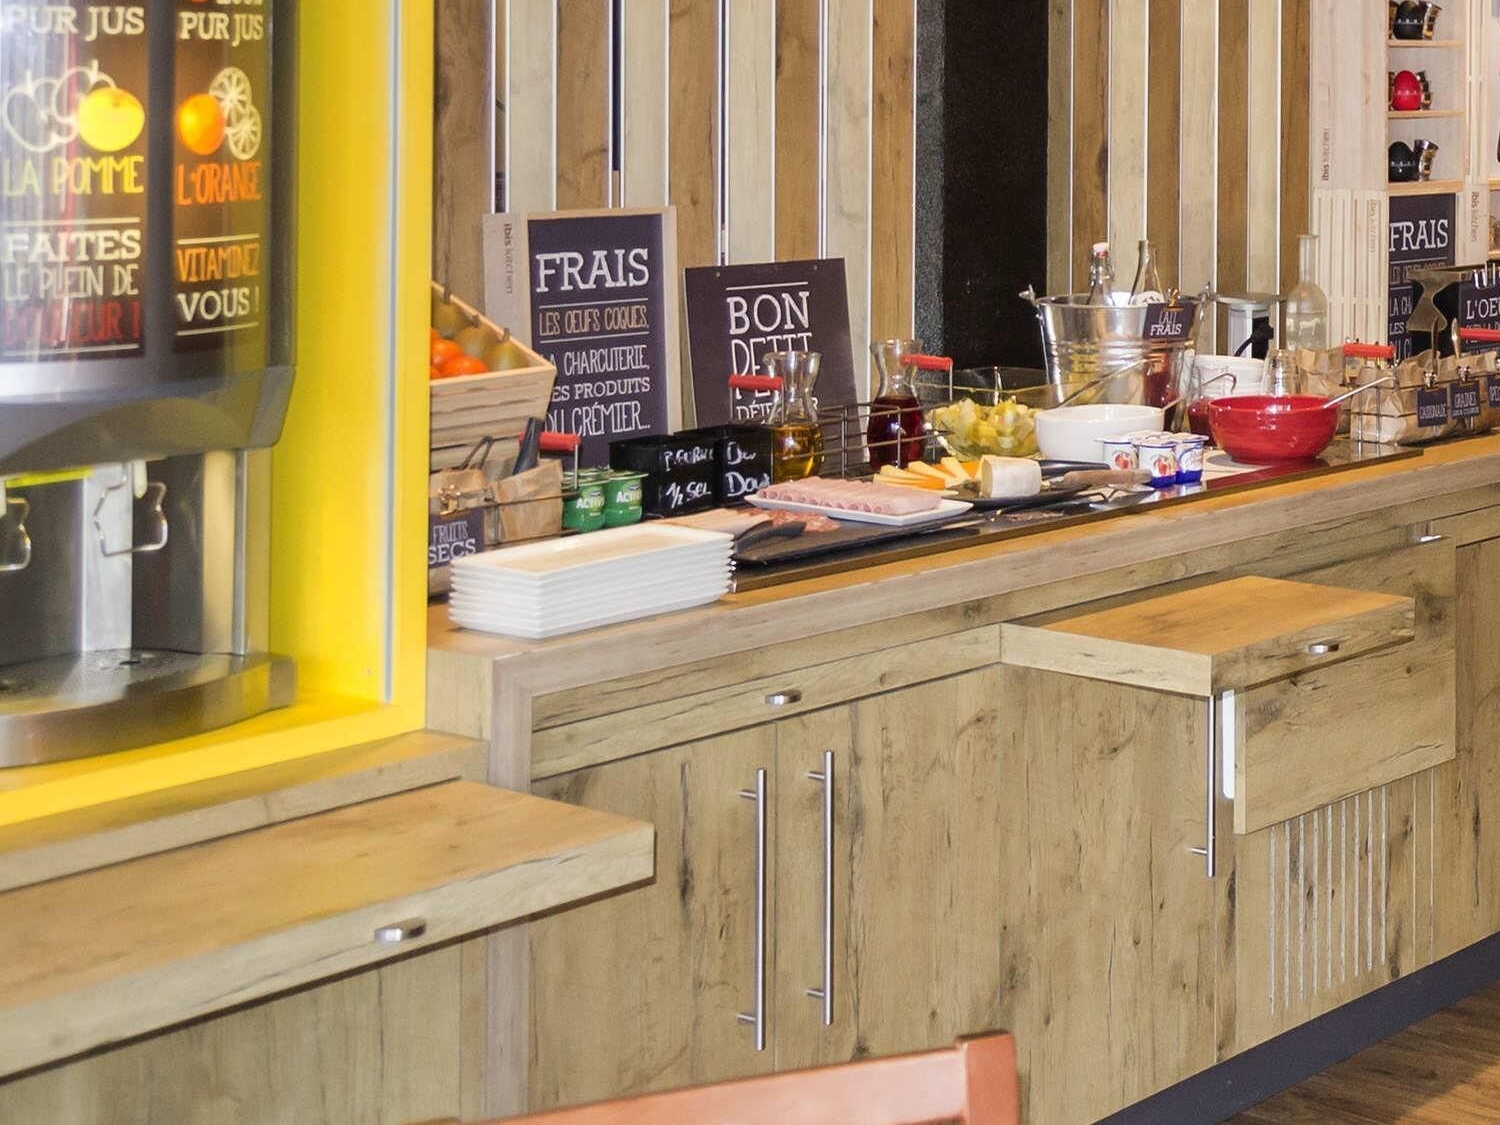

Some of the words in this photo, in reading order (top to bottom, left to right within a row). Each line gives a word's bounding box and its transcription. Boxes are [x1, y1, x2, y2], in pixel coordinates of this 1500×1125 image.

[2, 5, 79, 35] PUR
[85, 5, 145, 42] JUS
[179, 10, 230, 41] PUR
[232, 13, 265, 47] JUS
[3, 156, 42, 197] LA
[53, 155, 145, 195] POMME
[5, 229, 142, 263] FAITES
[1388, 219, 1449, 252] FRAIS
[4, 266, 31, 301] LE
[39, 264, 105, 300] PLEIN
[112, 263, 140, 296] DE
[535, 248, 650, 293] FRAIS
[177, 286, 251, 323] VOUS
[726, 291, 810, 335] BON
[539, 311, 561, 336] LES
[1150, 323, 1182, 336] FRAIS
[1389, 322, 1404, 335] LES
[551, 384, 570, 402] ES
[574, 376, 650, 400] PRODUITS
[428, 538, 476, 565] SECS
